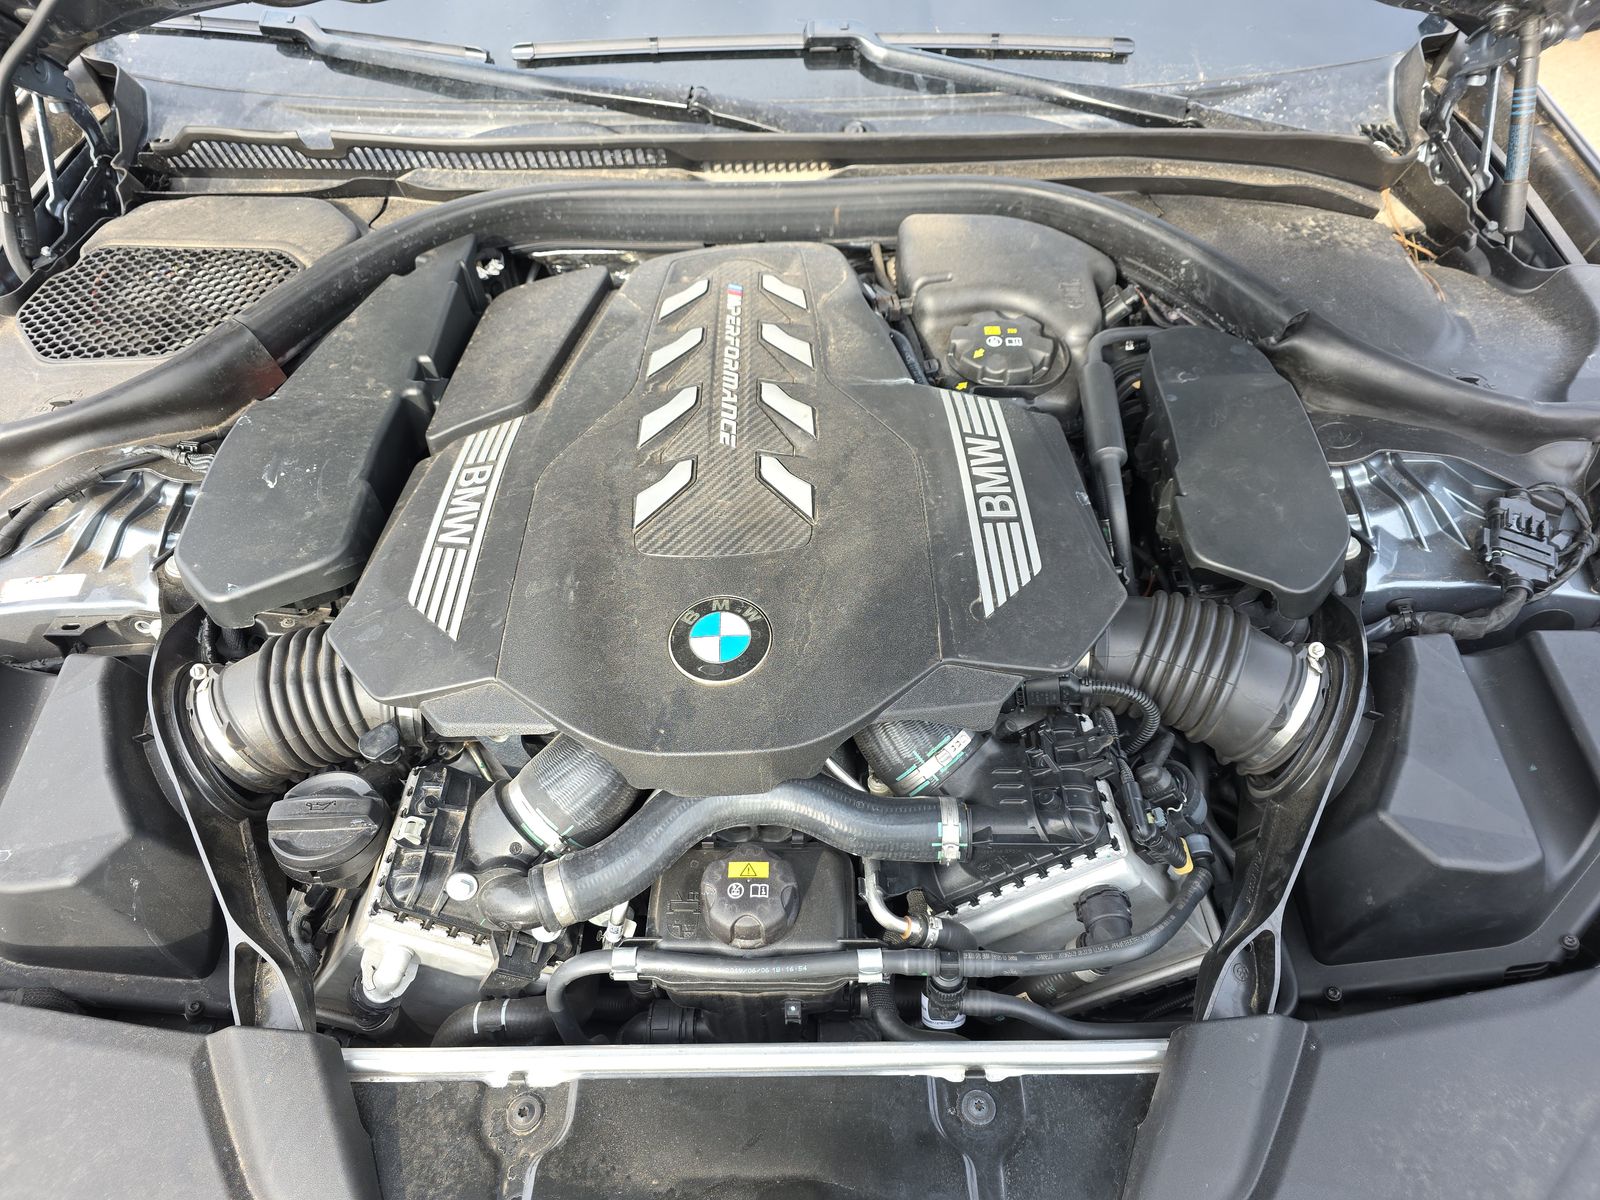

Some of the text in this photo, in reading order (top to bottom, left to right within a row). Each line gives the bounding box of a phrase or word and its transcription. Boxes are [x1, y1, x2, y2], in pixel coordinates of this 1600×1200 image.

[719, 303, 743, 448] PERFORMANCE
[437, 464, 494, 545] BMW
[964, 436, 1018, 518] BMW
[680, 598, 763, 626] BMW
